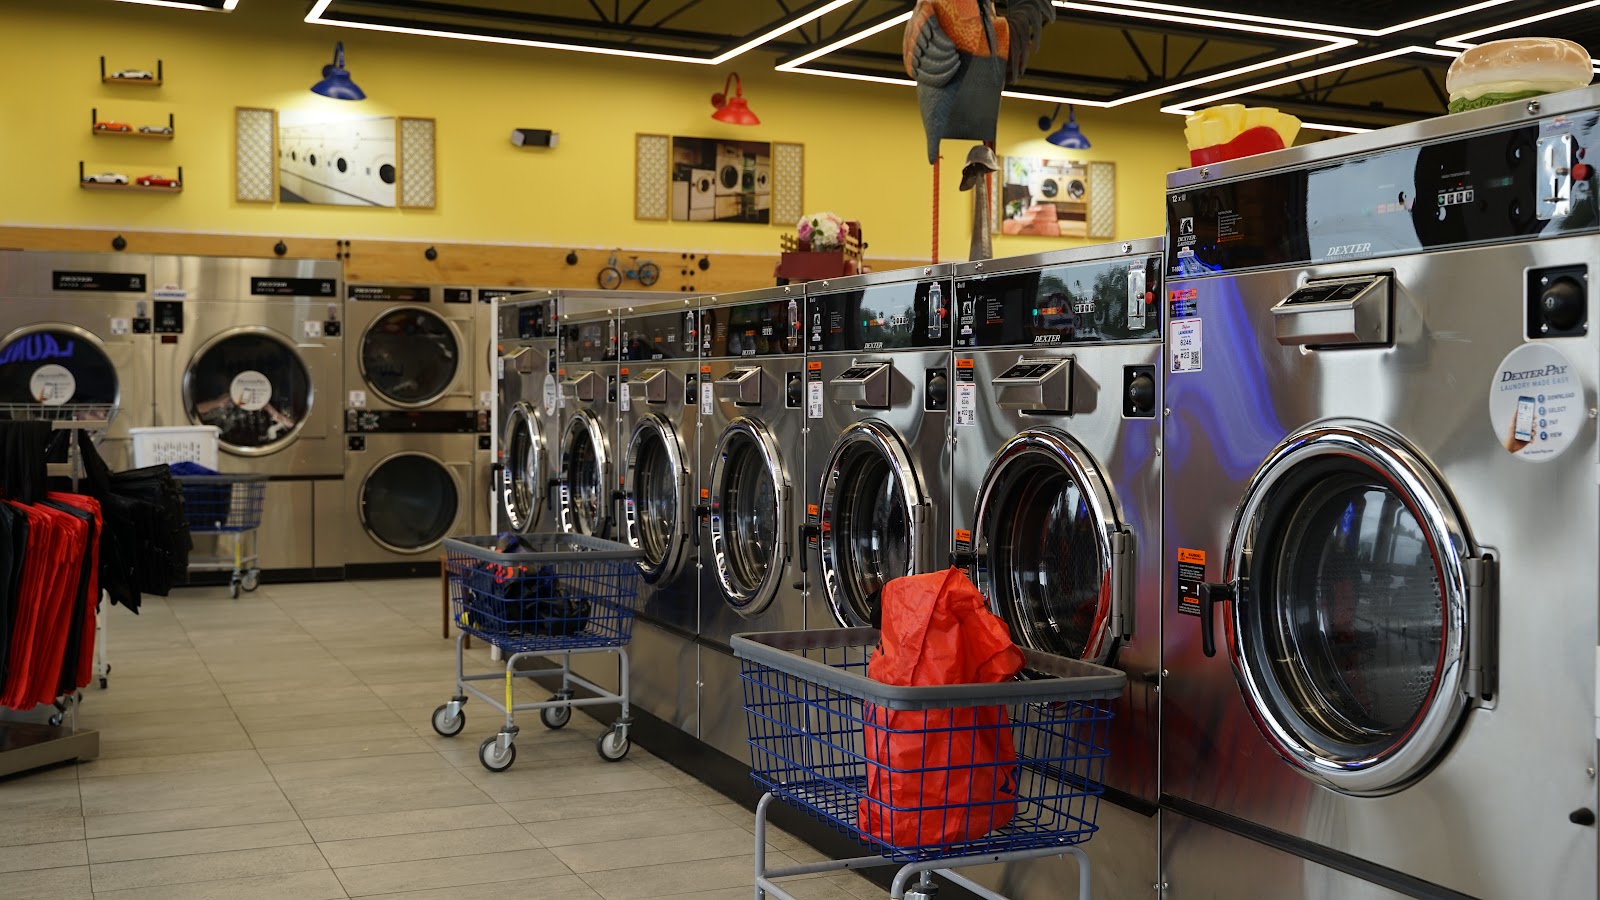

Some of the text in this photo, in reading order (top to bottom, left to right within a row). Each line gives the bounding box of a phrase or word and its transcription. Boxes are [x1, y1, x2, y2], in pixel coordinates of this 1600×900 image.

[1172, 195, 1178, 203] 12
[1326, 243, 1371, 256] DEXTER
[1501, 382, 1530, 391] LAUNDRY
[1552, 377, 1569, 385] EASY
